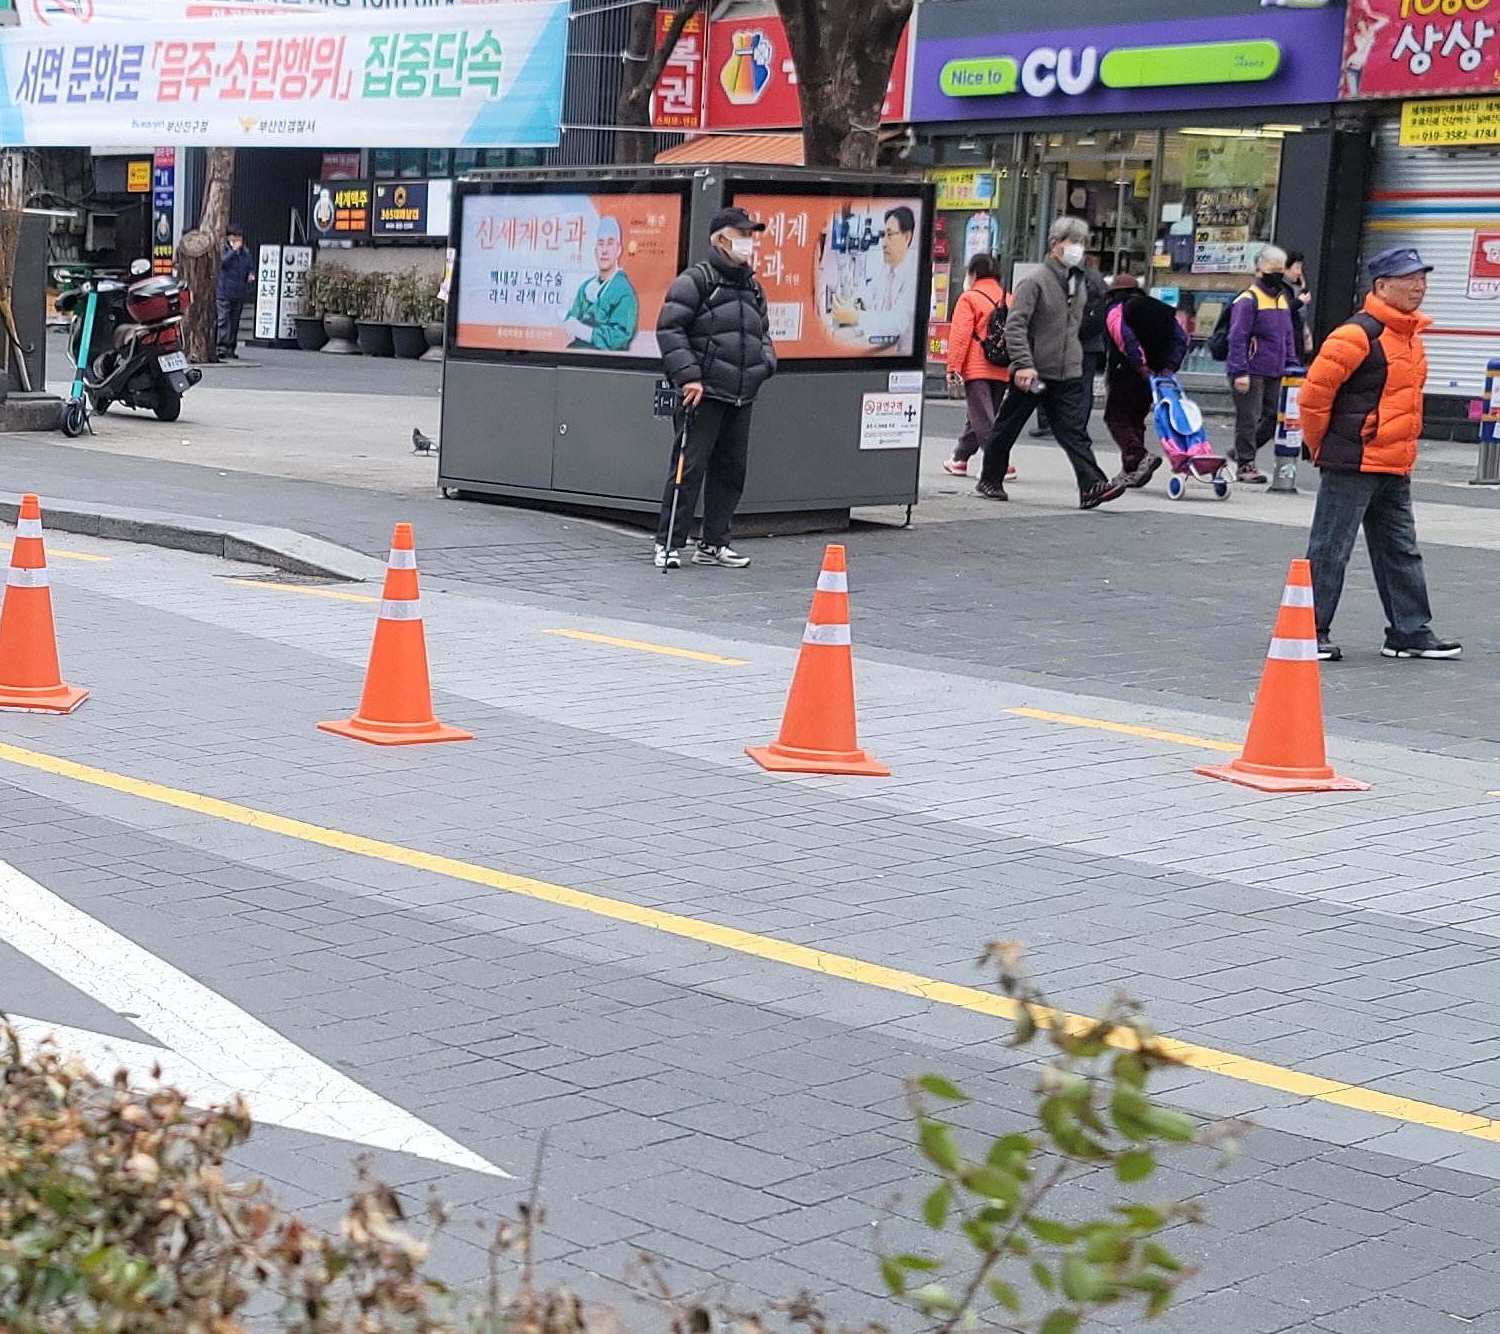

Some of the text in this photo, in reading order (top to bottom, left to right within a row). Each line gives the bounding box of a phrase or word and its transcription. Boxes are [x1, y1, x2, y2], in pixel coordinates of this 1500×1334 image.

[1391, 19, 1496, 75] 상상
[15, 44, 65, 105] 서면
[68, 43, 146, 104] 문화로
[361, 28, 504, 99] 집중단속
[658, 37, 700, 116] 복권
[951, 46, 1098, 98] Nice to CU
[166, 120, 209, 133] 부산진구청
[258, 121, 315, 135] 부산진경찰서
[475, 214, 588, 252] 신세계안과
[261, 269, 276, 283] 호프
[524, 269, 563, 286] 노안수술
[489, 289, 509, 305] 라식
[543, 290, 562, 305] ICL
